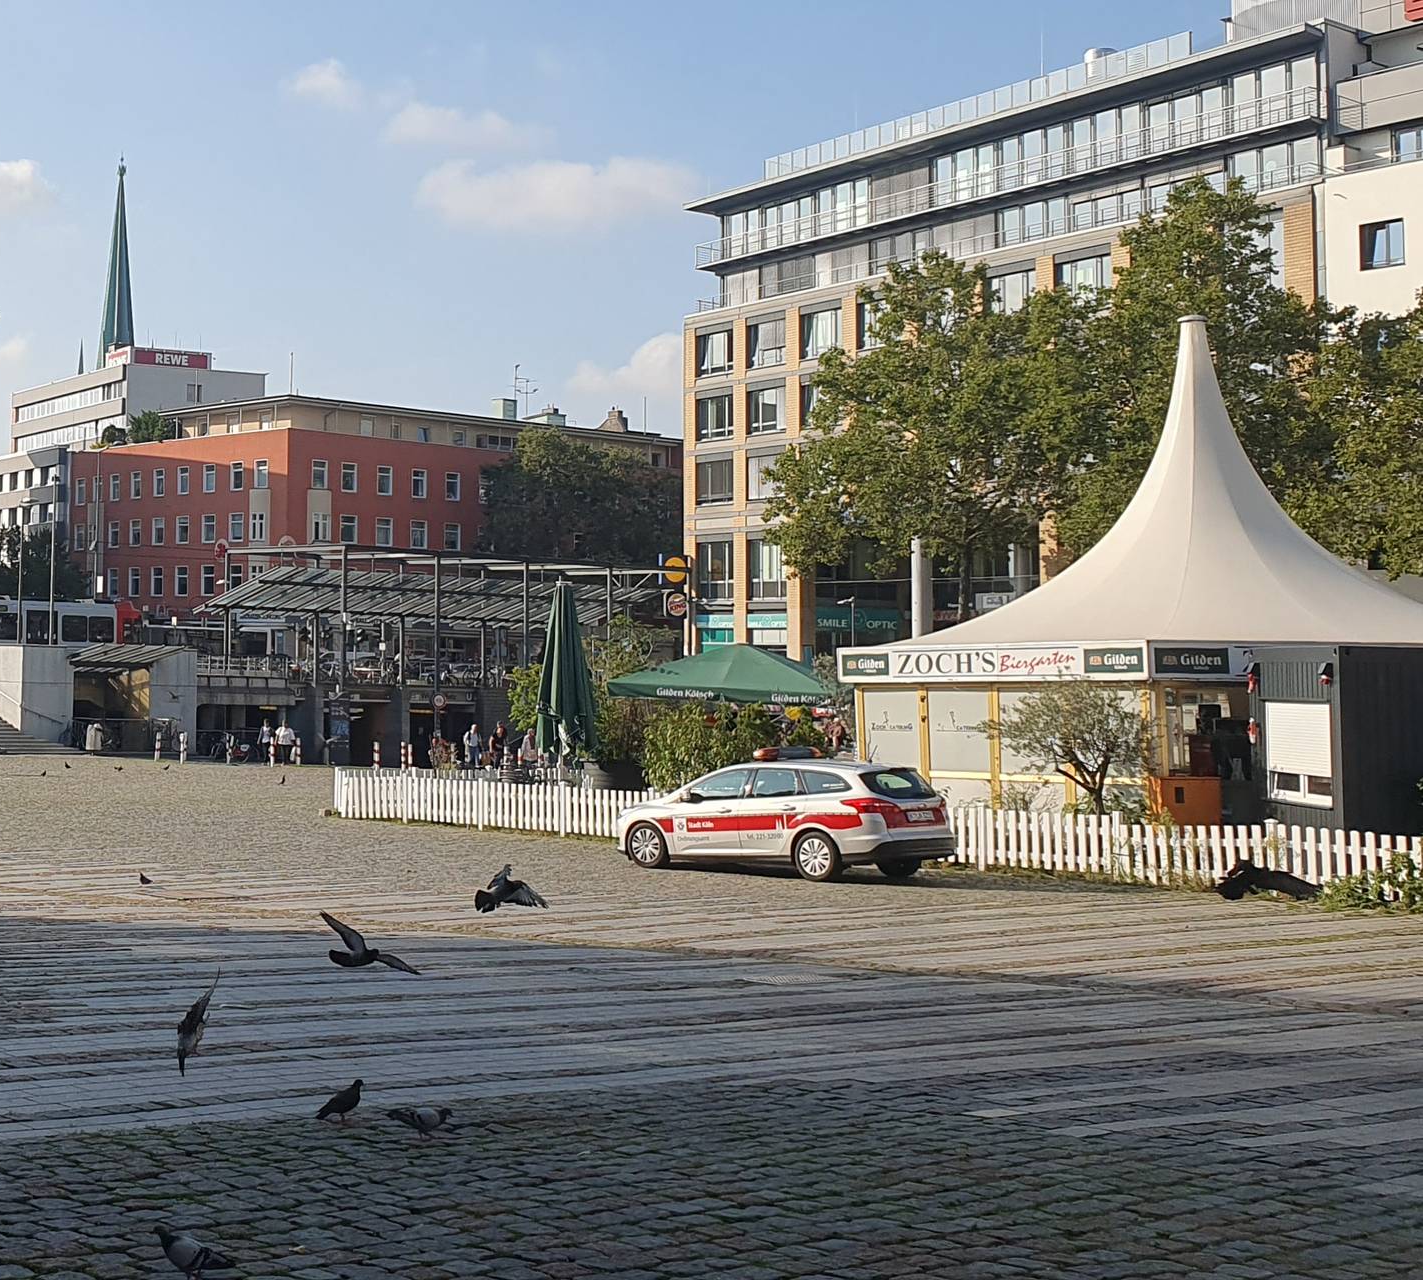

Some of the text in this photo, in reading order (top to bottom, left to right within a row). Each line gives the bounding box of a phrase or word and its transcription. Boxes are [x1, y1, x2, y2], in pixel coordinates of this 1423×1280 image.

[155, 353, 189, 366] REWE
[817, 618, 897, 629] SMILE OPTIC
[858, 658, 885, 669] Gilden
[898, 651, 1076, 675] ZOCH'S Biergarten
[1103, 653, 1139, 665] Gilden
[1180, 653, 1222, 665] Gilden
[656, 687, 714, 700] Gilden Kölsch
[771, 693, 799, 703] Gilden
